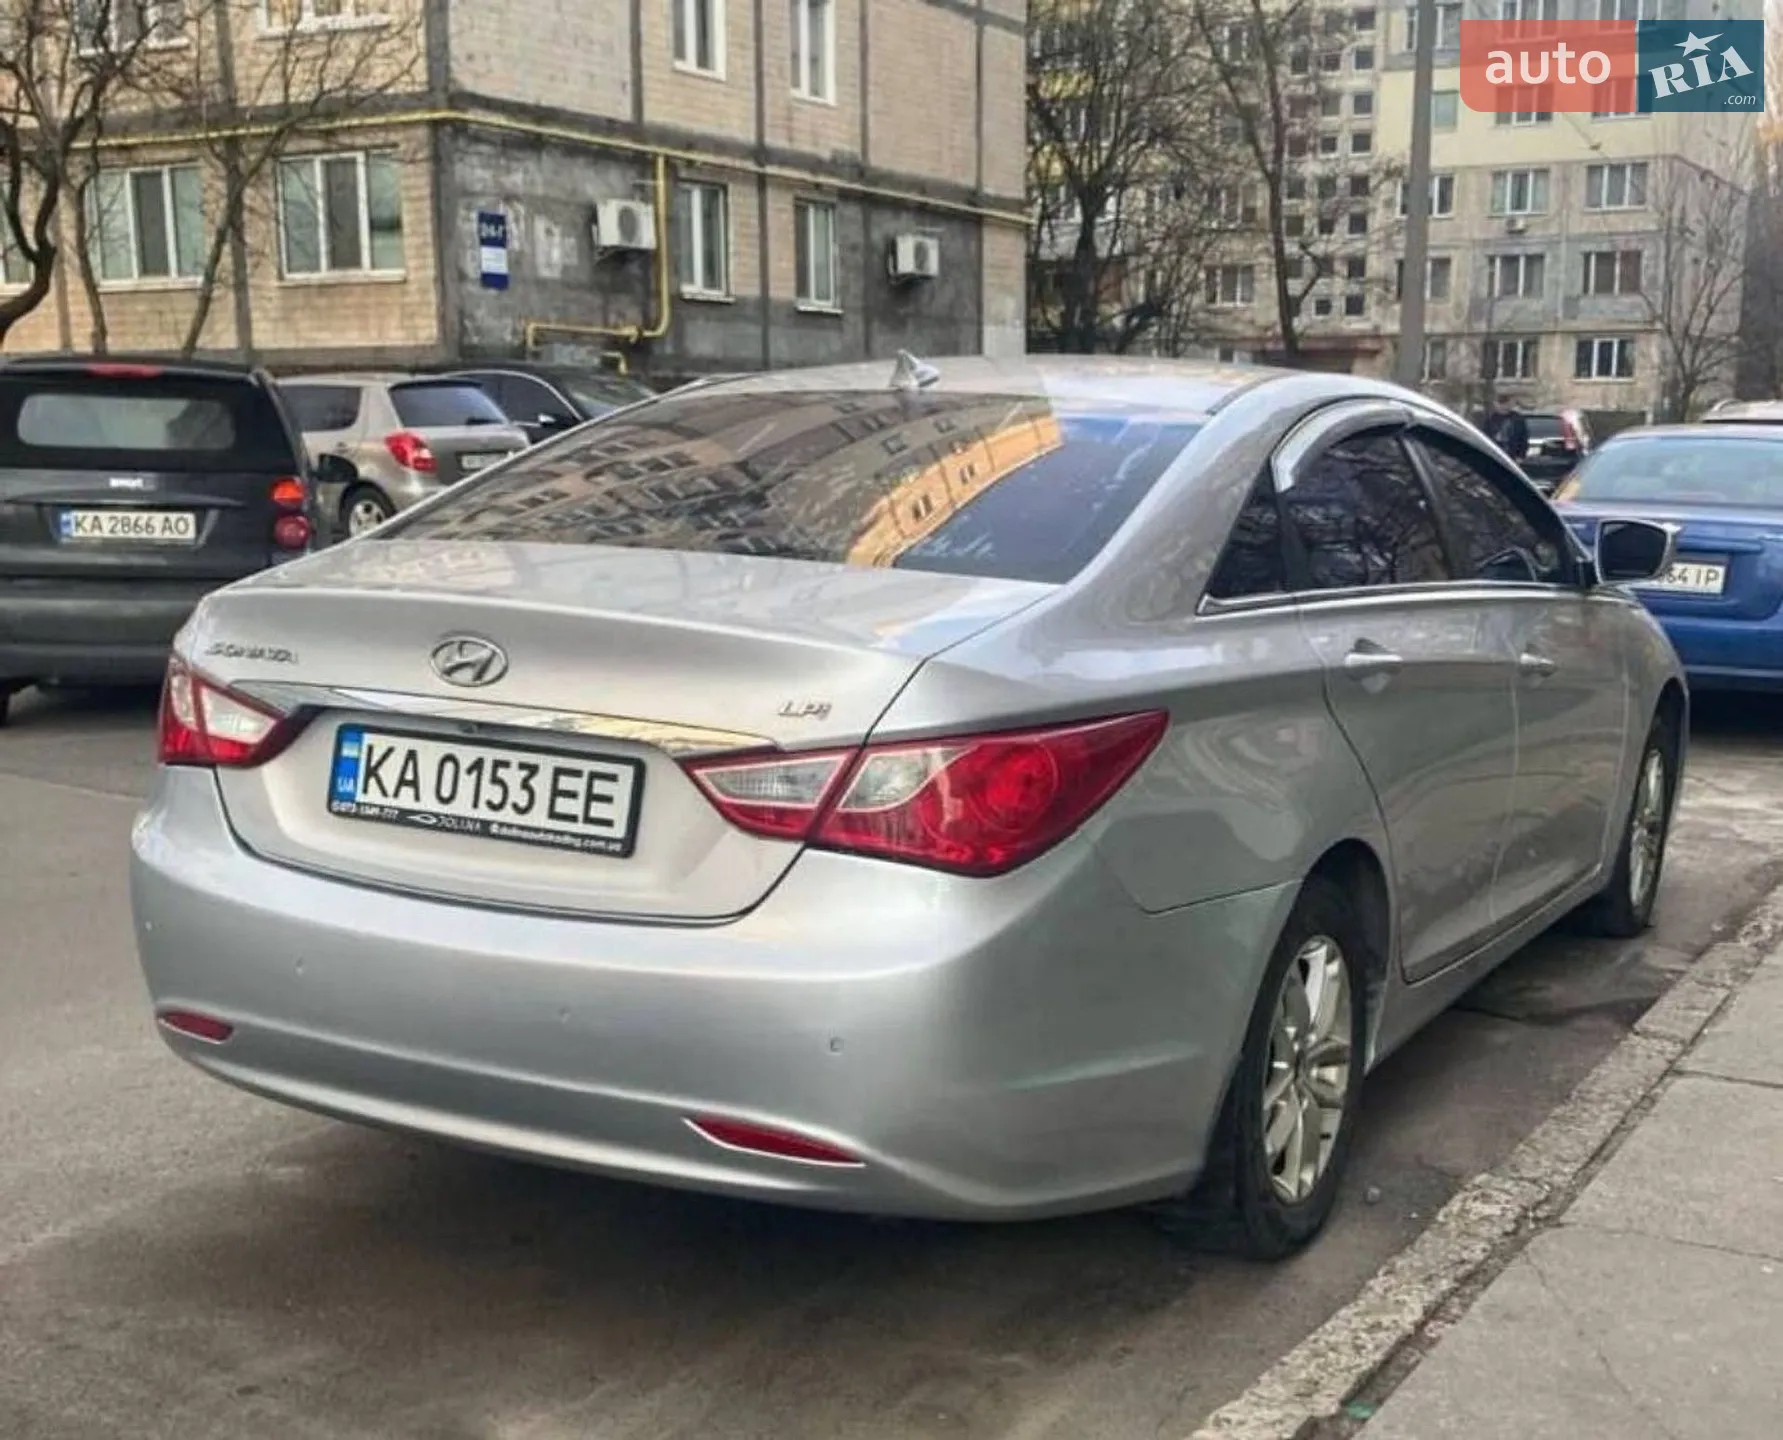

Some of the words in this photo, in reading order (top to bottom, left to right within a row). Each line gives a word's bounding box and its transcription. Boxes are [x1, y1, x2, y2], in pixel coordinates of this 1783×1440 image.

[75, 515, 102, 534] KA
[108, 515, 155, 535] 2866
[161, 515, 190, 535] AO
[362, 744, 421, 802] KA
[435, 753, 539, 815] 0153
[548, 765, 619, 828] EE
